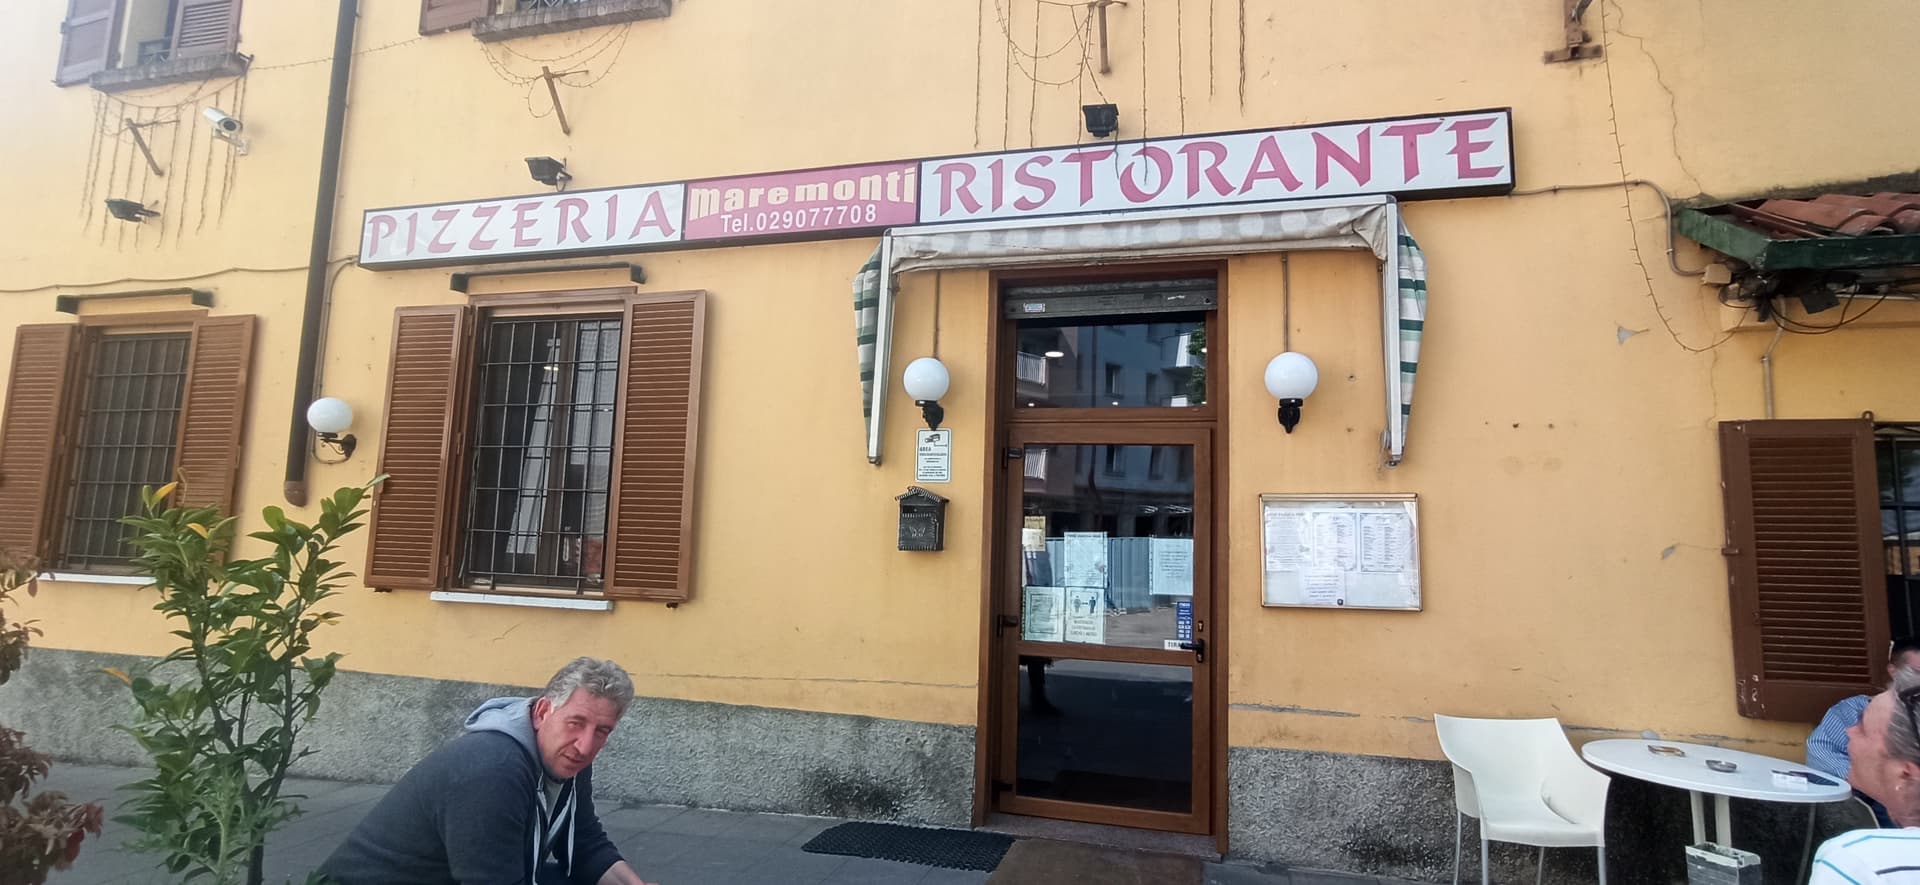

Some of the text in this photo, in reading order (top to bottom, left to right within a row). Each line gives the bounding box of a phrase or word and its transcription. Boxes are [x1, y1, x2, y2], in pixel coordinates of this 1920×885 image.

[689, 167, 916, 221] maremonti
[933, 117, 1504, 217] RISTORANTE
[368, 190, 677, 259] PIZZERIA
